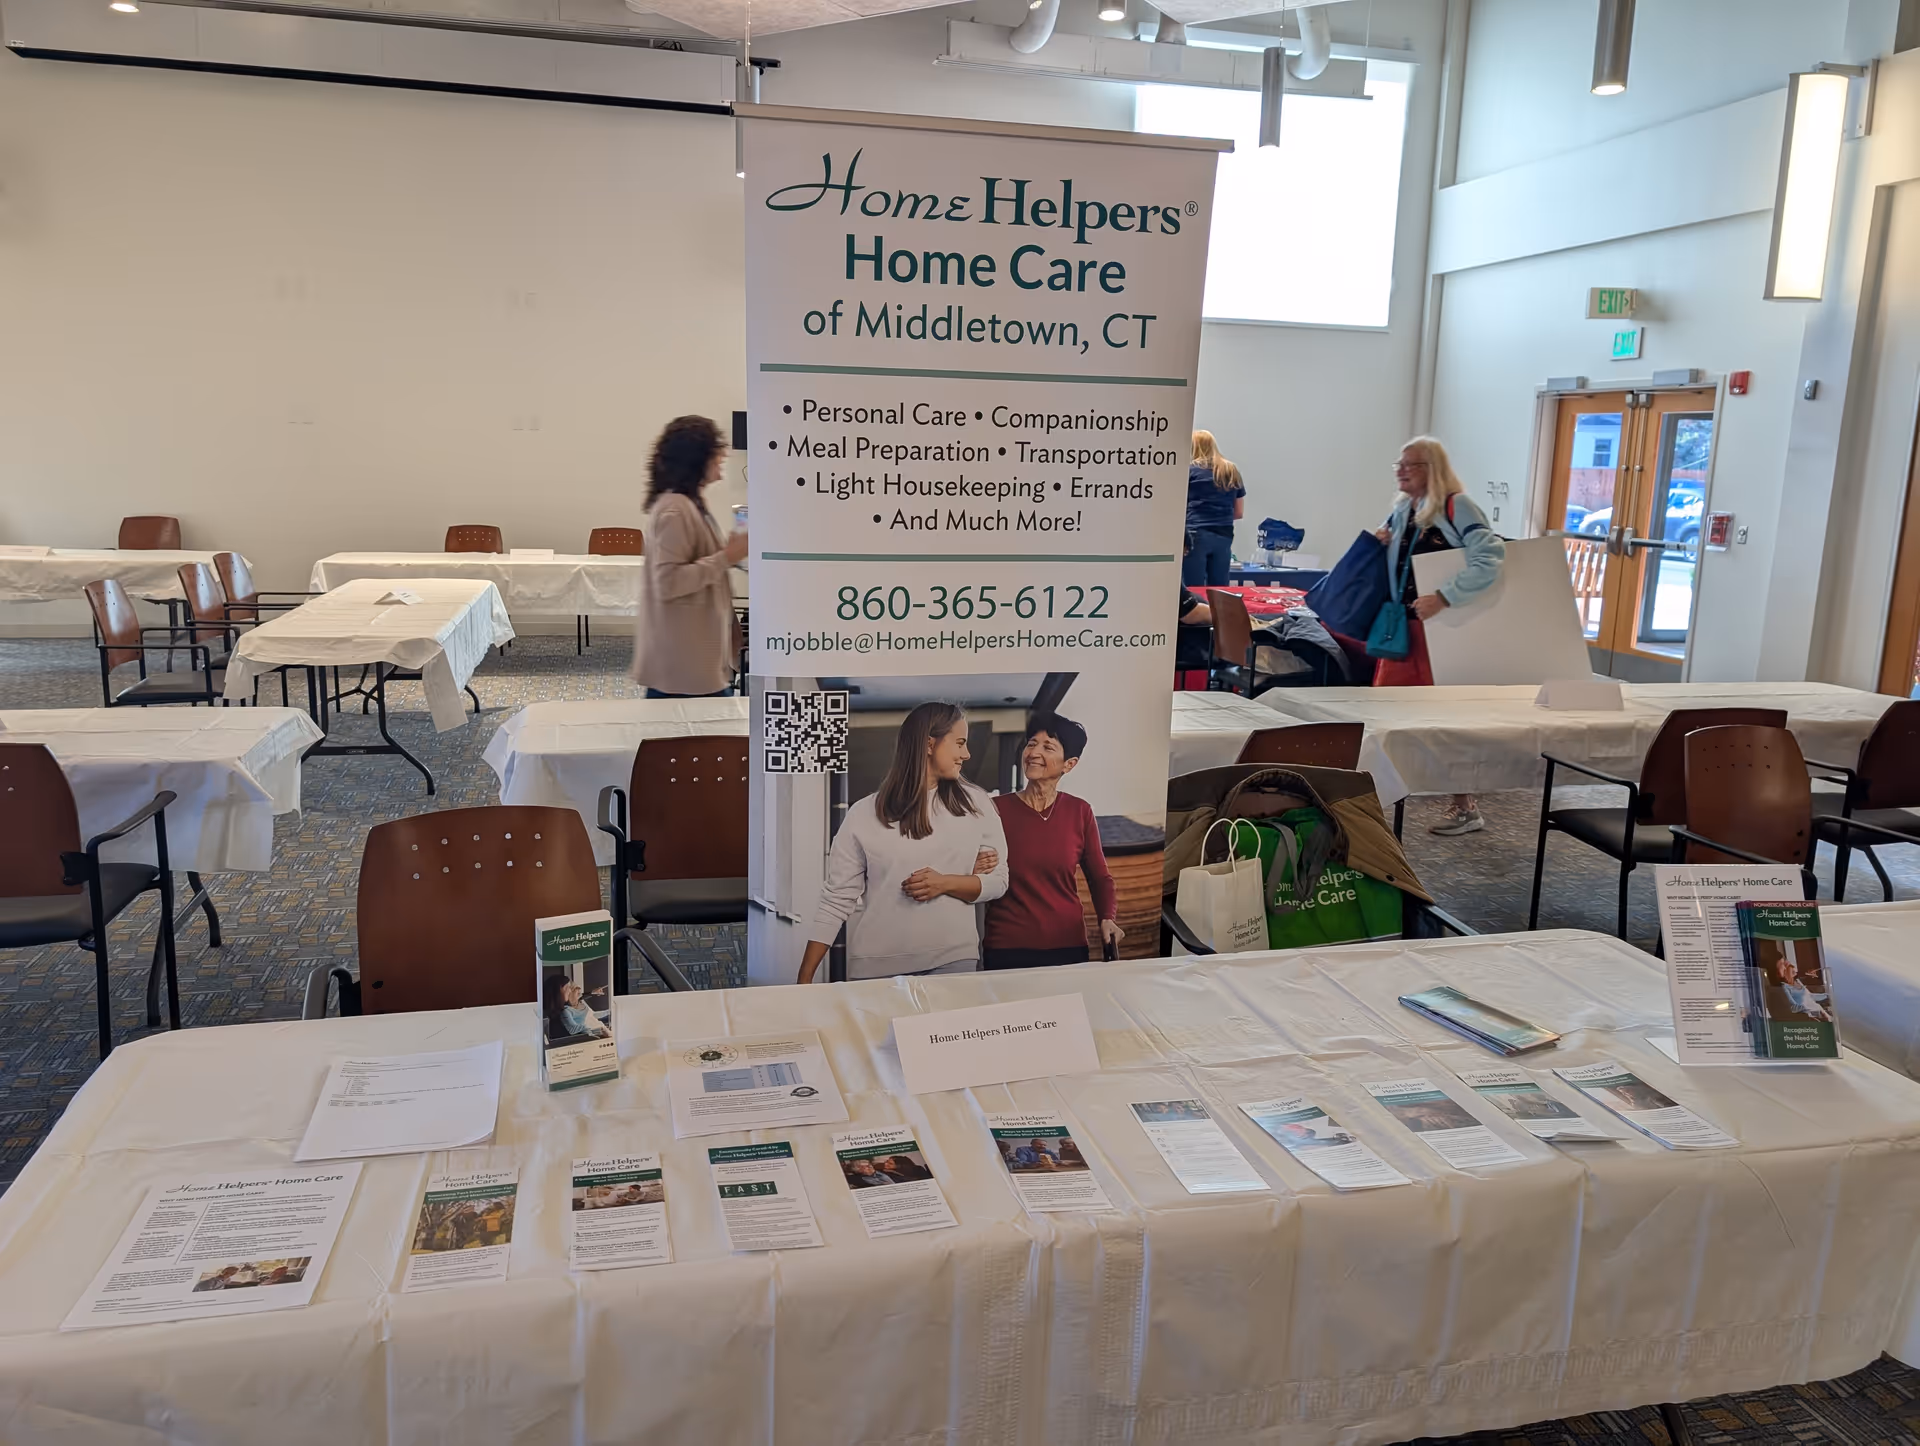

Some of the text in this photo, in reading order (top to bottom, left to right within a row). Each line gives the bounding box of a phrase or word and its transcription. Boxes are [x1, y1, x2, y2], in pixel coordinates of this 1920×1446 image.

[765, 147, 973, 221] Home
[845, 233, 1127, 294] Home Care
[1598, 290, 1625, 314] EXIT
[803, 299, 1157, 355] of Middletown, CT
[1613, 330, 1637, 357] EXIT
[802, 399, 967, 427] Personal Care
[991, 406, 1170, 435] Companionship
[787, 435, 990, 466] Meal Preparation
[1015, 441, 1177, 468] Transportation
[815, 471, 1045, 503] Light Housekeeping
[1070, 477, 1154, 500] Errands
[890, 508, 1082, 532] And Much More!
[836, 584, 1110, 621] 860-365-6122
[765, 628, 1167, 656] mjobble@HomeHelpersHomeCare.com
[1316, 868, 1365, 888] elpes
[1743, 877, 1770, 887] Home
[1771, 877, 1793, 886] Care
[1317, 888, 1357, 906] Care
[1768, 919, 1807, 927] Home Care
[559, 940, 600, 952] Home Care
[929, 1019, 1058, 1044] Home Helpers Home Care
[850, 1136, 896, 1147] Home Care
[587, 1166, 616, 1174] Home
[166, 1183, 216, 1194] Home
[275, 1177, 312, 1186] Home
[314, 1173, 343, 1183] Care
[445, 1178, 498, 1189] Home Care
